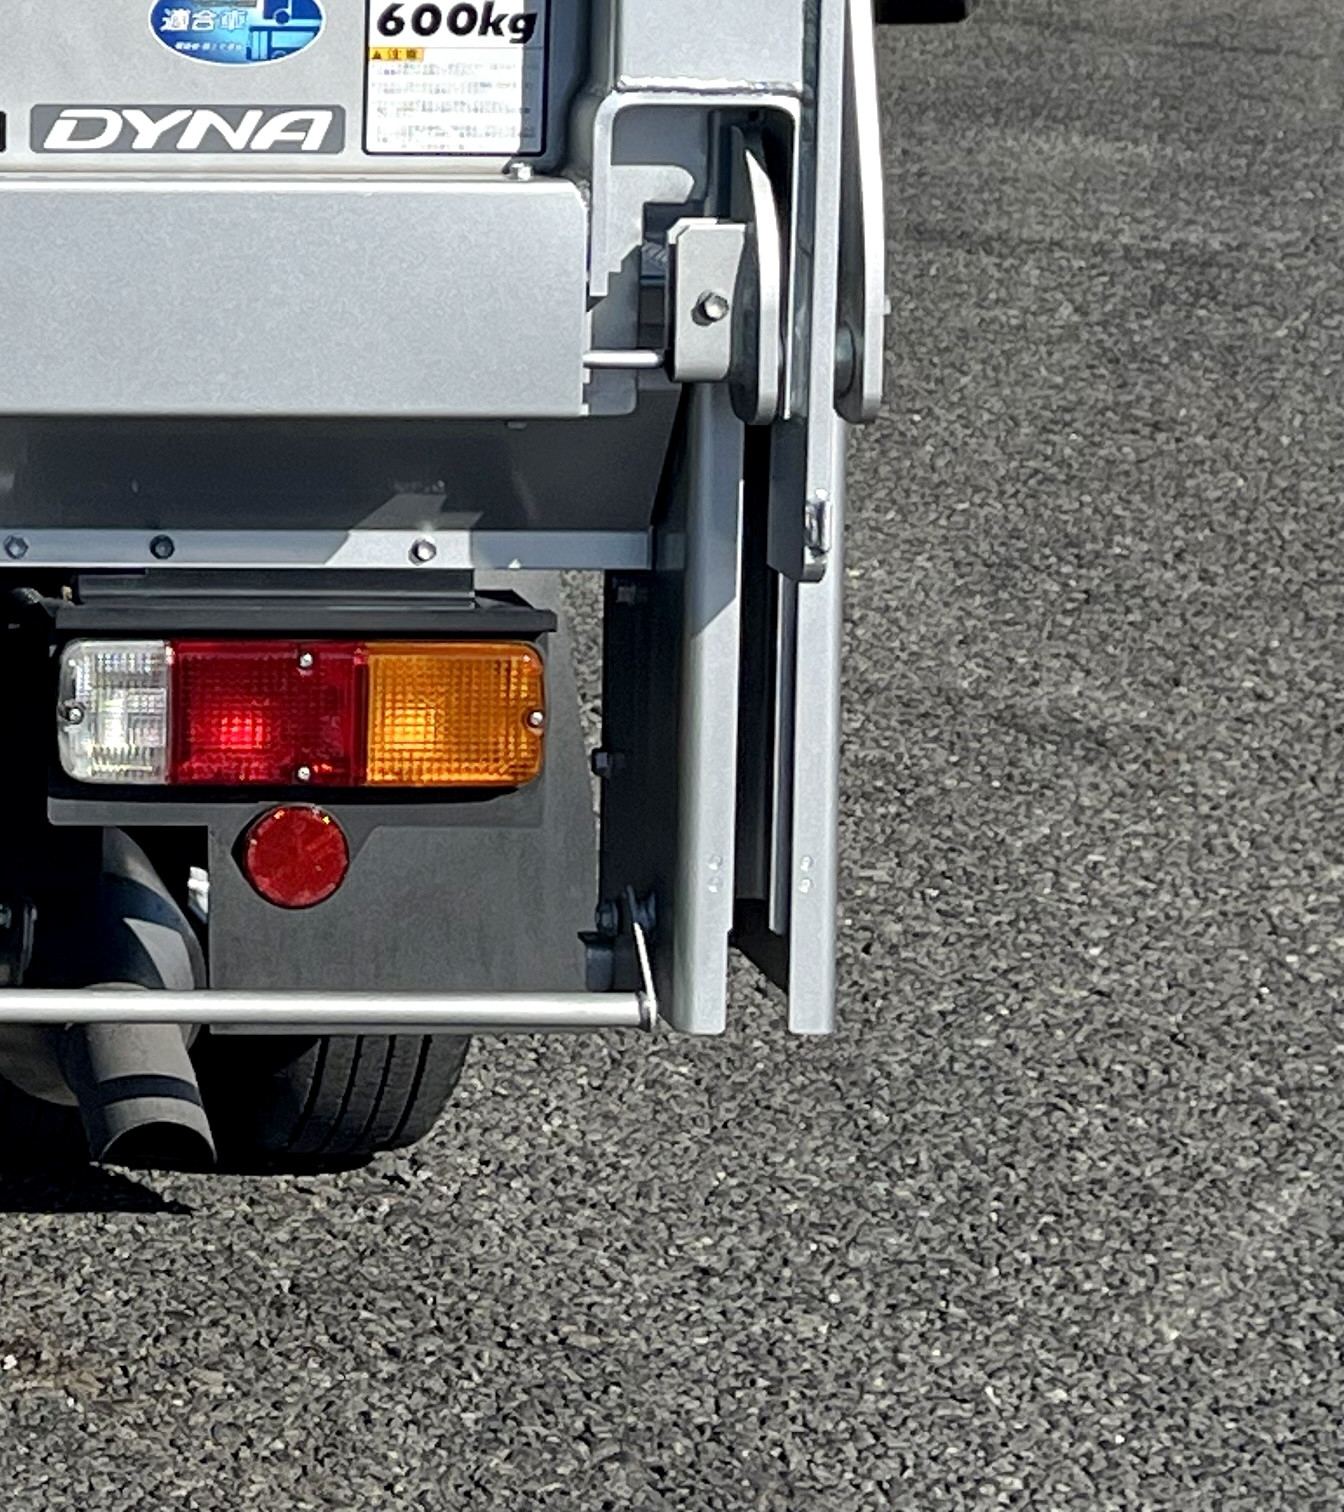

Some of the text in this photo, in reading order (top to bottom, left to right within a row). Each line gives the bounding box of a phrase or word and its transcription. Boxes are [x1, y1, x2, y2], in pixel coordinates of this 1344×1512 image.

[160, 8, 248, 32] 適合車
[376, 0, 538, 44] 600kg
[43, 108, 333, 151] DYNA
